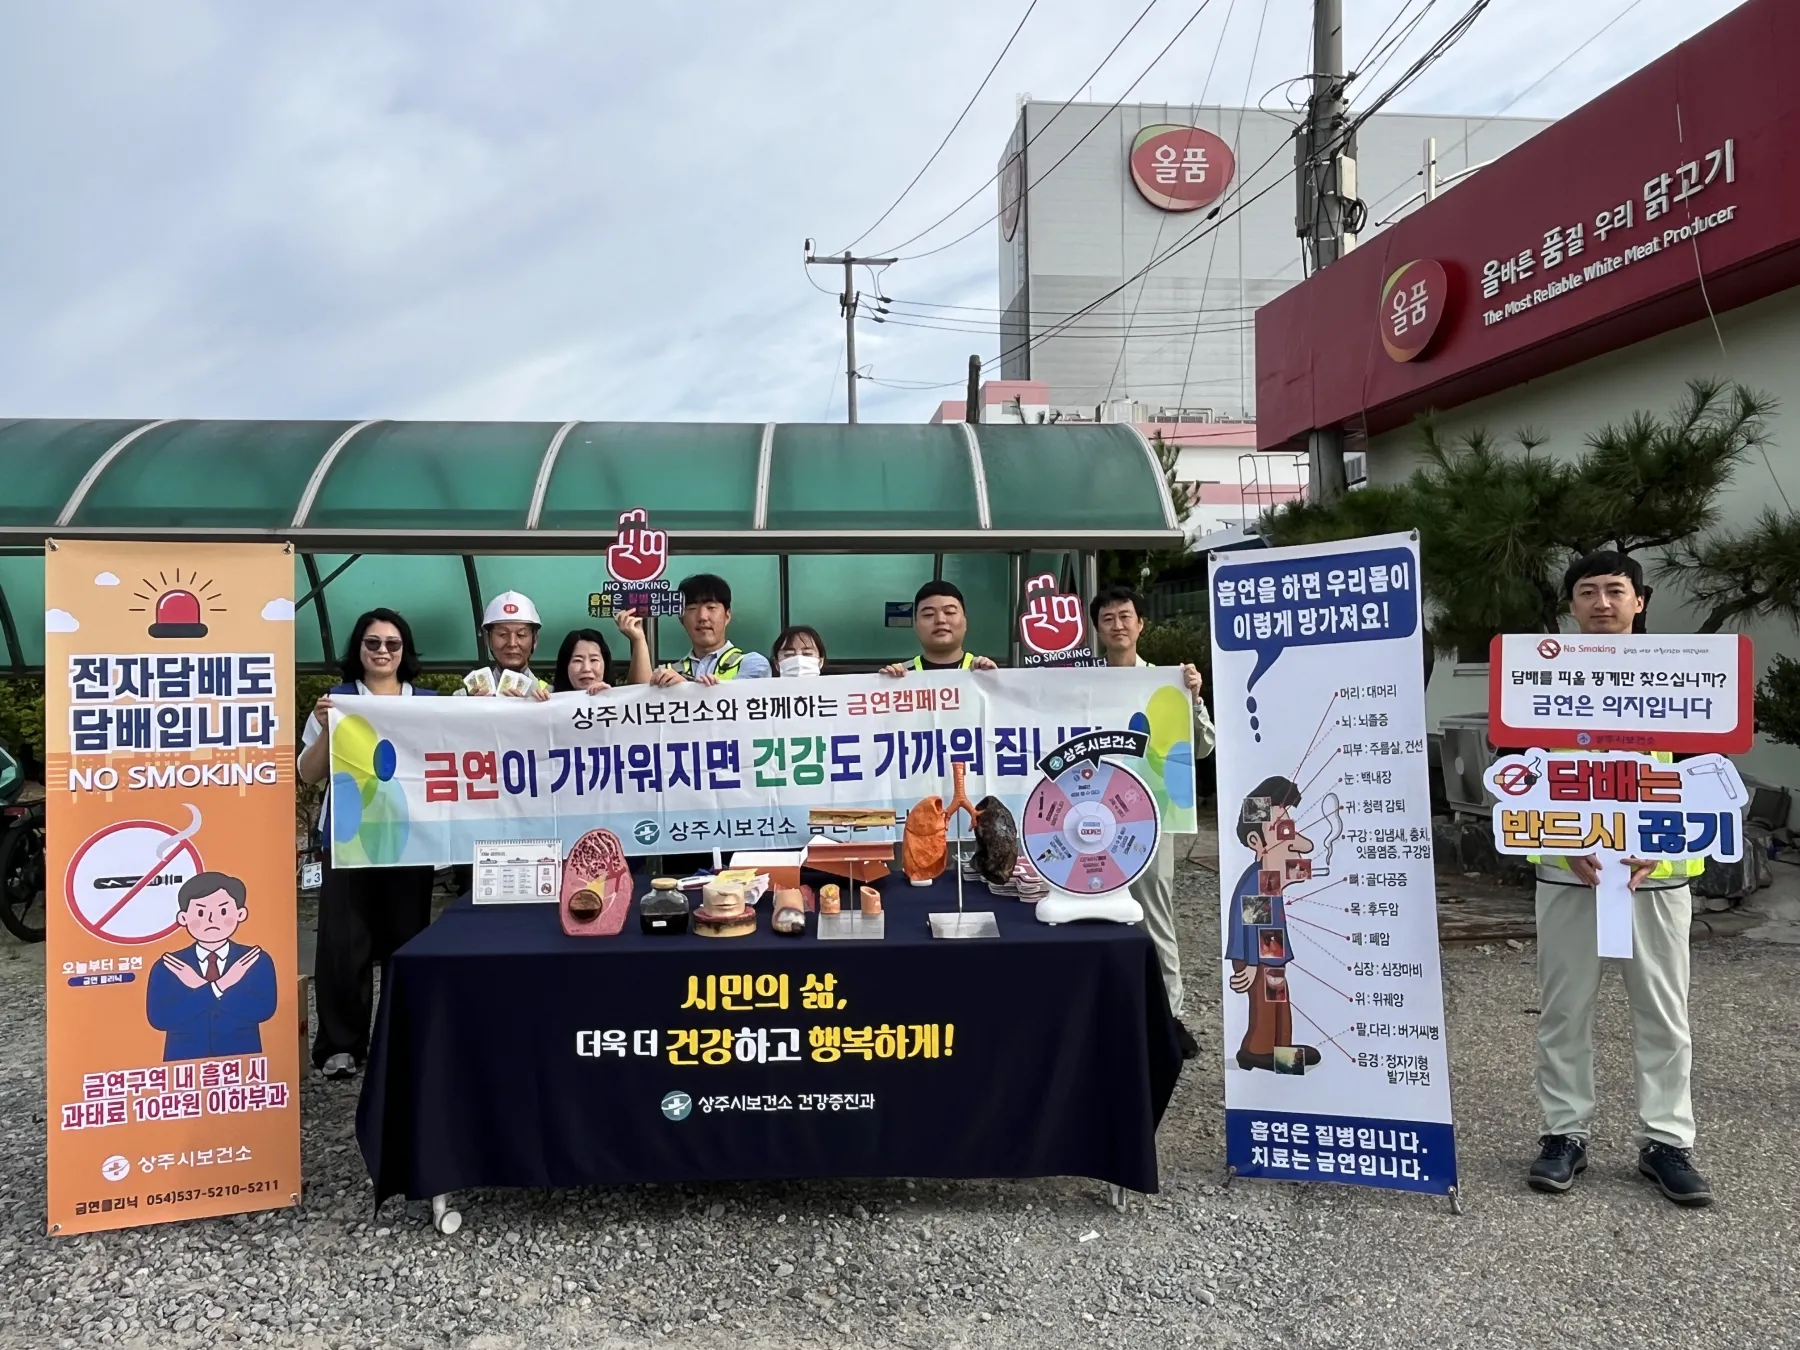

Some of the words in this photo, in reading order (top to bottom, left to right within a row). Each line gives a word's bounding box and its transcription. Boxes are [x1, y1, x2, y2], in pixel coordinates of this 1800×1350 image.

[1151, 144, 1210, 184] 올품
[1481, 248, 1537, 299] 올바른
[1541, 222, 1585, 270] 품질
[1593, 200, 1634, 242] 우리
[1643, 138, 1735, 222] 닭고기
[1482, 308, 1503, 327] The
[1504, 292, 1534, 319] Most
[1533, 272, 1584, 303] Reliable
[1583, 255, 1623, 282] White
[1624, 236, 1663, 266] Meat
[1663, 204, 1738, 249] Producer
[1390, 278, 1429, 337] 올품
[604, 583, 620, 591] NO
[622, 581, 669, 590] SMOKING
[1217, 576, 1277, 607] 흡연을
[1281, 571, 1321, 601] 하면
[1233, 609, 1293, 641] 이렇게
[1297, 601, 1390, 636] 망가져요!
[1024, 654, 1041, 665] NO
[1043, 647, 1091, 663] SMOKING
[1563, 645, 1576, 653] No
[1578, 644, 1616, 654] Smoking
[71, 655, 276, 700] 전자담배도
[1366, 684, 1397, 699] 대머리
[1511, 670, 1552, 686] 담배를
[1558, 670, 1586, 686] 피울
[1639, 671, 1727, 688] 찾으십니까?
[571, 698, 739, 730] 상주시보건소와
[746, 694, 838, 721] 함께하는
[847, 687, 960, 716] 금연캠페인
[1532, 694, 1594, 717] 금연은
[1602, 695, 1713, 720] 의지입니다
[72, 704, 277, 750] 담배입니다
[1062, 735, 1137, 763] 상주시보건소
[68, 767, 119, 792] NO
[128, 761, 278, 789] SMOKING
[424, 749, 538, 803] 금연이
[548, 739, 741, 796] 가까워지면
[752, 735, 863, 788] 건강도
[1361, 769, 1392, 785] 백내장
[1547, 759, 1683, 803] 담배는
[668, 815, 797, 842] 상주시보건소
[1501, 809, 1626, 852] 반드시
[1637, 809, 1736, 856] 끊기
[1402, 844, 1431, 860] 구강암
[1366, 872, 1408, 887] 골다공증
[1368, 901, 1400, 917] 후두암
[117, 956, 143, 971] 금연
[1381, 962, 1423, 978] 심장마비
[680, 972, 789, 1011] 시민의
[799, 972, 848, 1010] 삶,
[575, 1029, 628, 1057] 더욱
[633, 1029, 658, 1057] 더
[665, 1026, 803, 1066] 건강하고
[808, 1022, 955, 1064] 행복하게!
[1398, 1023, 1439, 1040] 버거씨병
[1386, 1053, 1428, 1071] 정자기형
[84, 1067, 168, 1099] 금연구역
[175, 1065, 194, 1089] 내
[201, 1061, 240, 1087] 흡연
[248, 1058, 266, 1083] 시
[1387, 1069, 1431, 1086] 발기부전
[62, 1101, 126, 1128] 과태료
[133, 1092, 201, 1120] 10만원
[208, 1084, 288, 1113] 이하부과
[698, 1093, 793, 1114] 상주시보건소
[796, 1092, 876, 1112] 건강증진과
[1250, 1120, 1310, 1145] 흡연은
[1315, 1124, 1428, 1154] 질병입니다.
[137, 1145, 252, 1174] 상주시보건소
[1251, 1146, 1311, 1170] 치료는
[1315, 1151, 1430, 1182] 금연입니다.
[147, 1179, 279, 1206] 054)537-5210-5211
